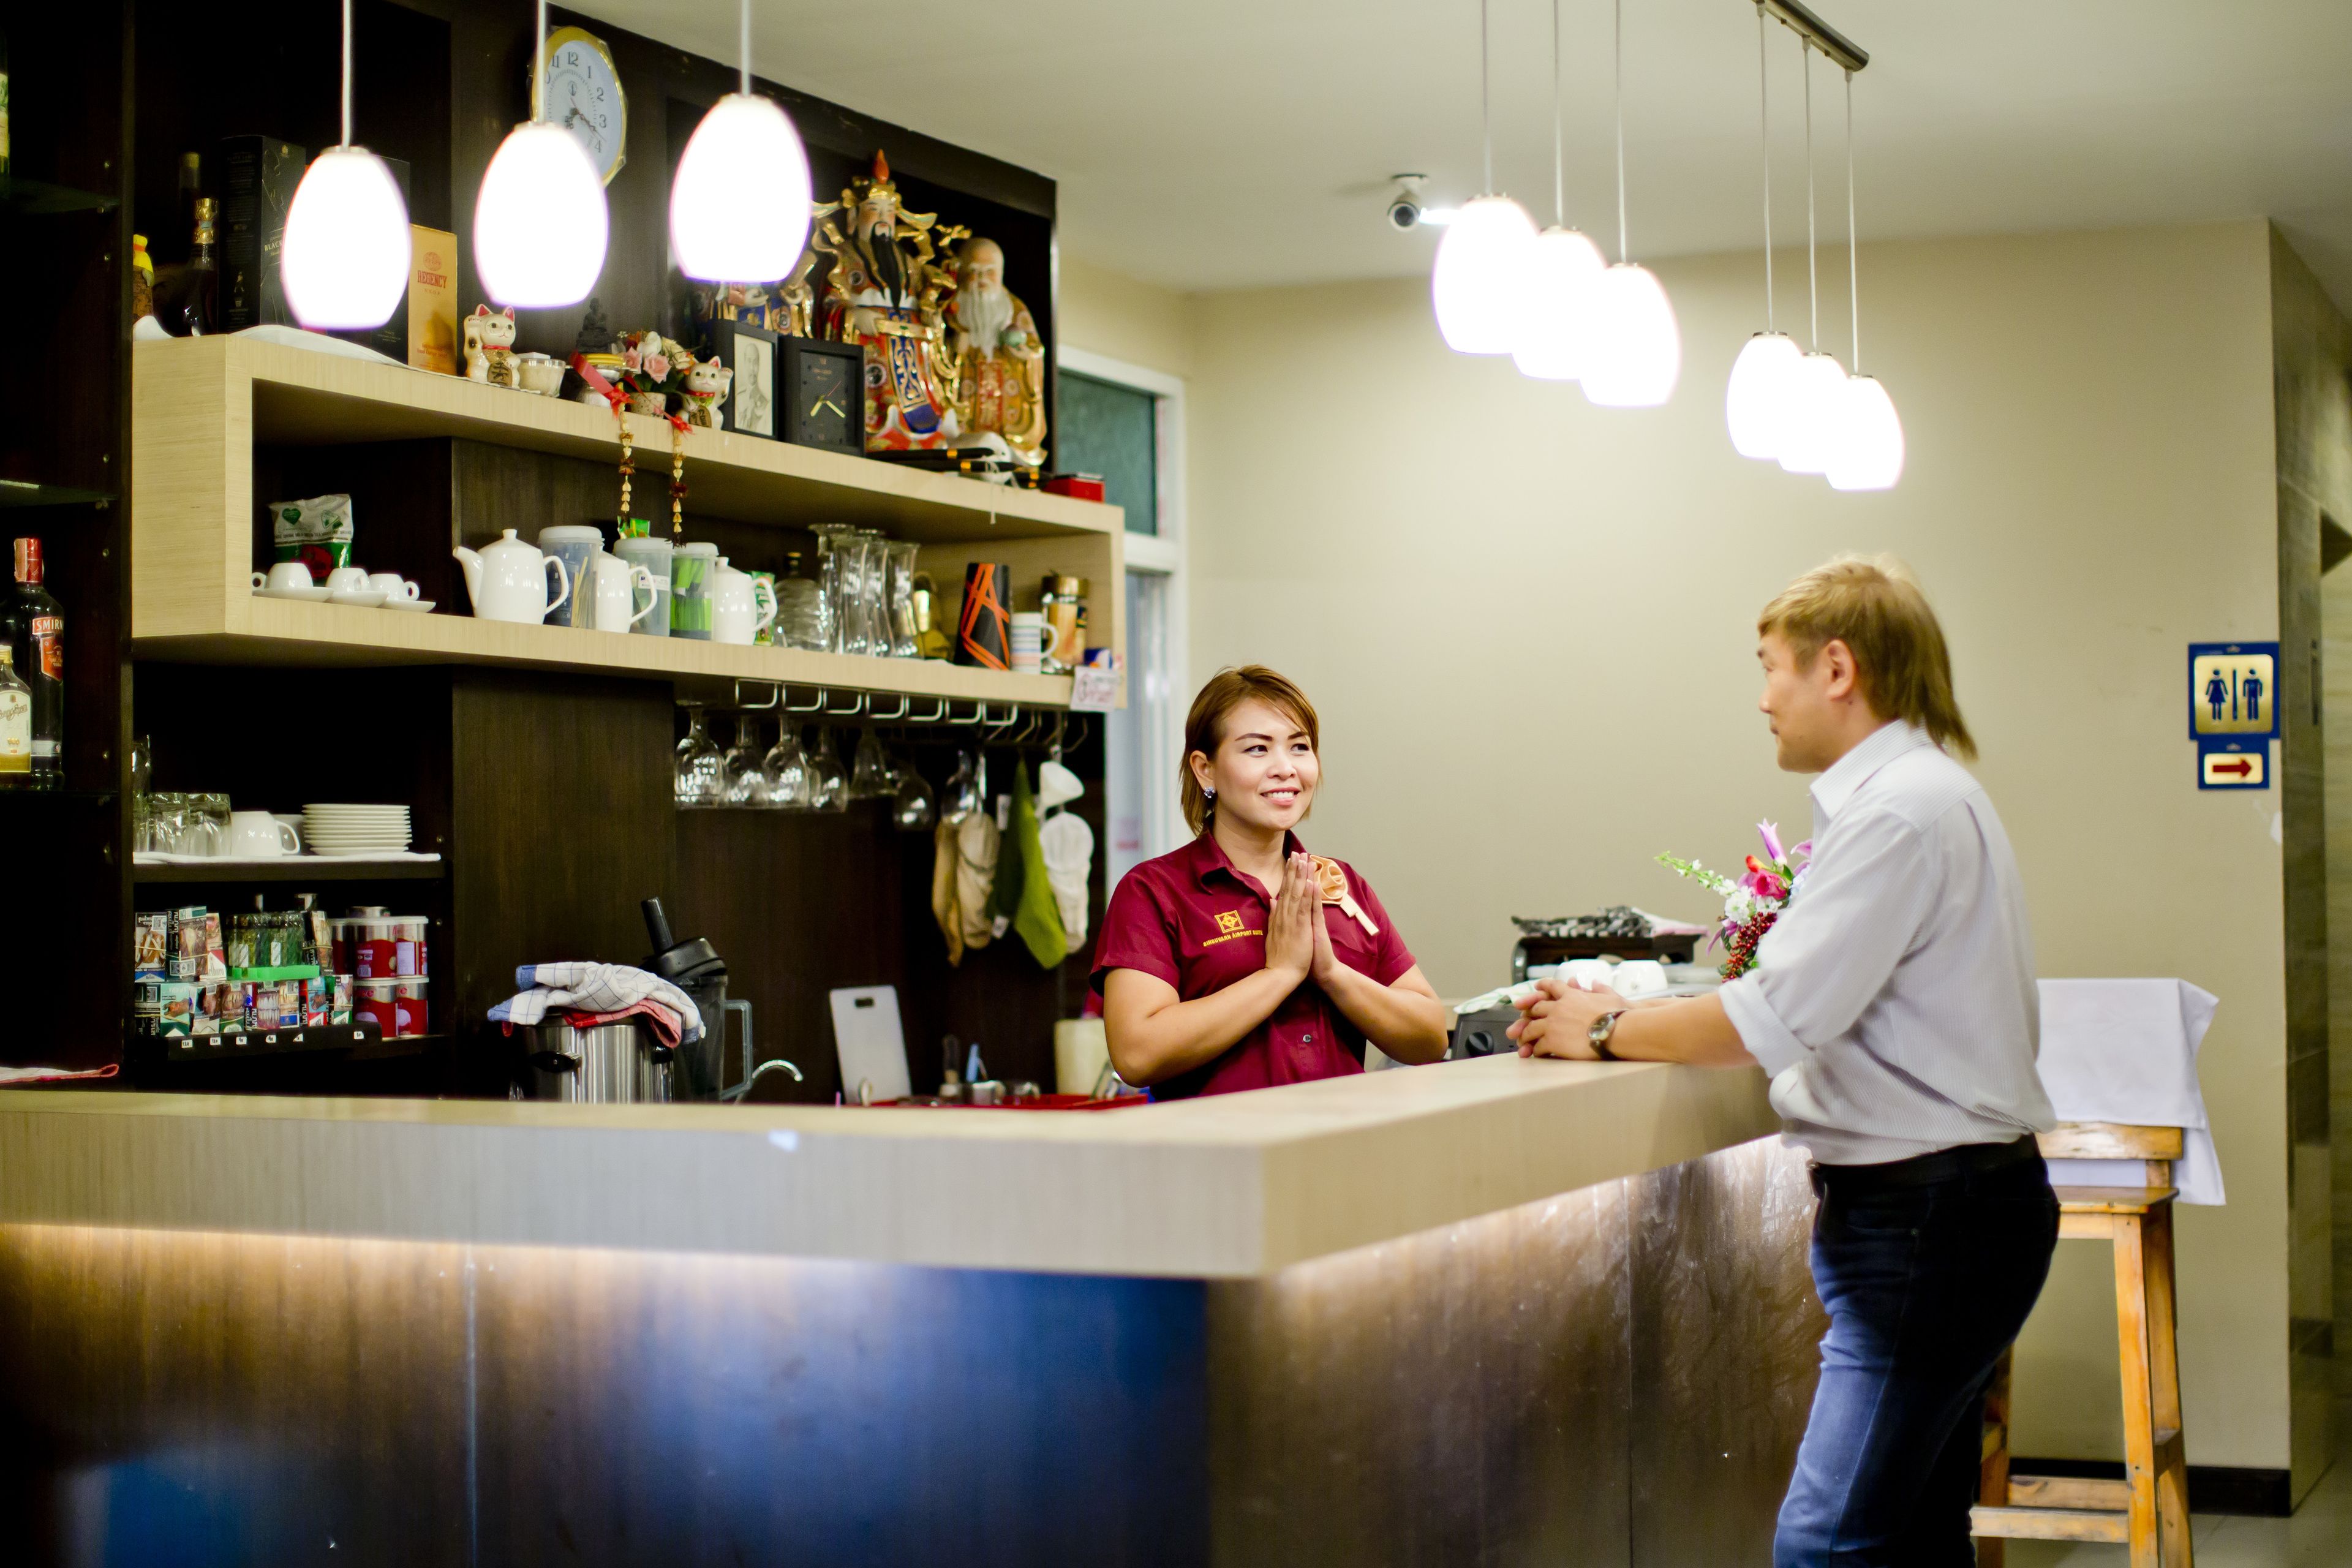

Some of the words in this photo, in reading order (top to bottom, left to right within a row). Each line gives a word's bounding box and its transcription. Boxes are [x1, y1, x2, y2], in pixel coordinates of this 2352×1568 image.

[567, 51, 579, 67] 12
[587, 66, 592, 79] 1
[597, 87, 604, 102] 2
[599, 114, 606, 128] 3
[594, 140, 602, 153] 4
[417, 270, 447, 288] REGENCY
[1232, 930, 1252, 938] AIRPORT
